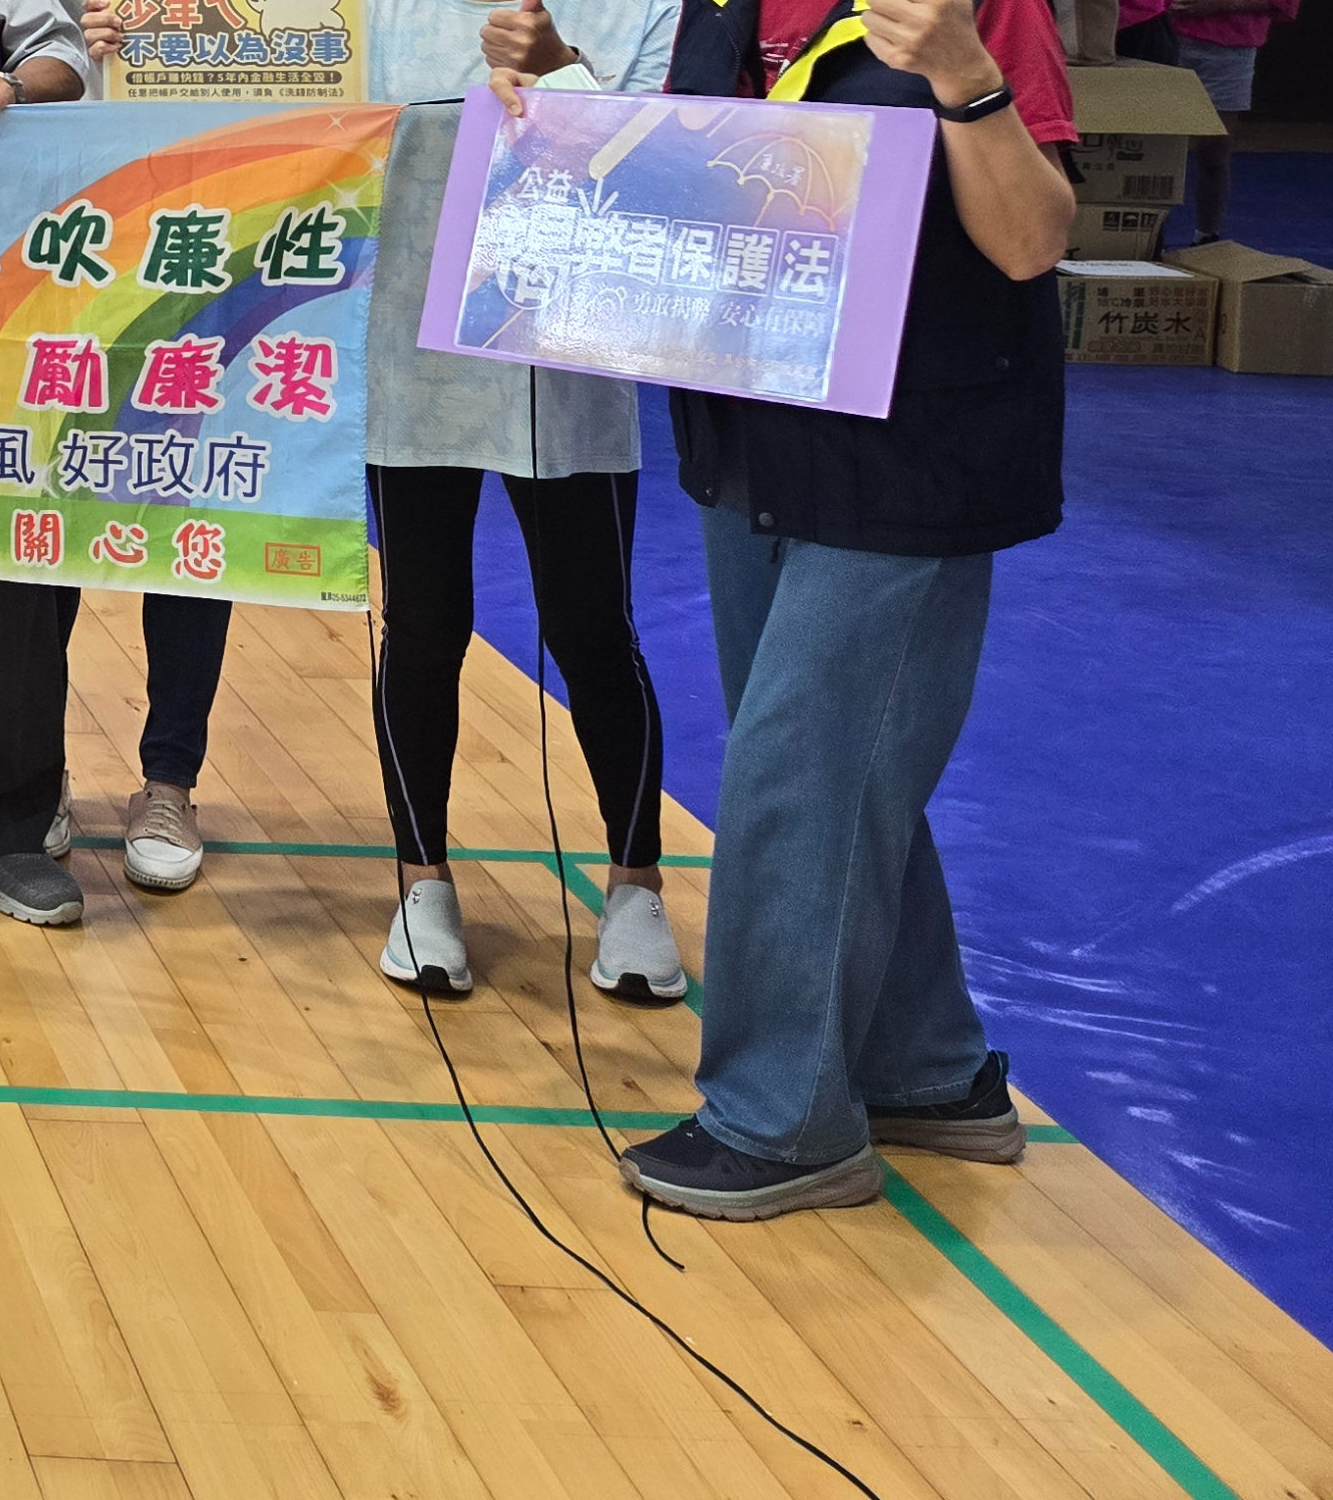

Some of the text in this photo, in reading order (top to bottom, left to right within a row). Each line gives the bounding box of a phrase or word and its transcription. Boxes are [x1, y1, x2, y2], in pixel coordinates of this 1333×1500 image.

[120, 29, 351, 66] 不要以為沒事
[517, 166, 576, 205] 公益
[1097, 310, 1192, 335] 竹炭水
[62, 433, 267, 499] 好政府
[14, 510, 223, 580] 關心您
[271, 548, 316, 571] 廣告
